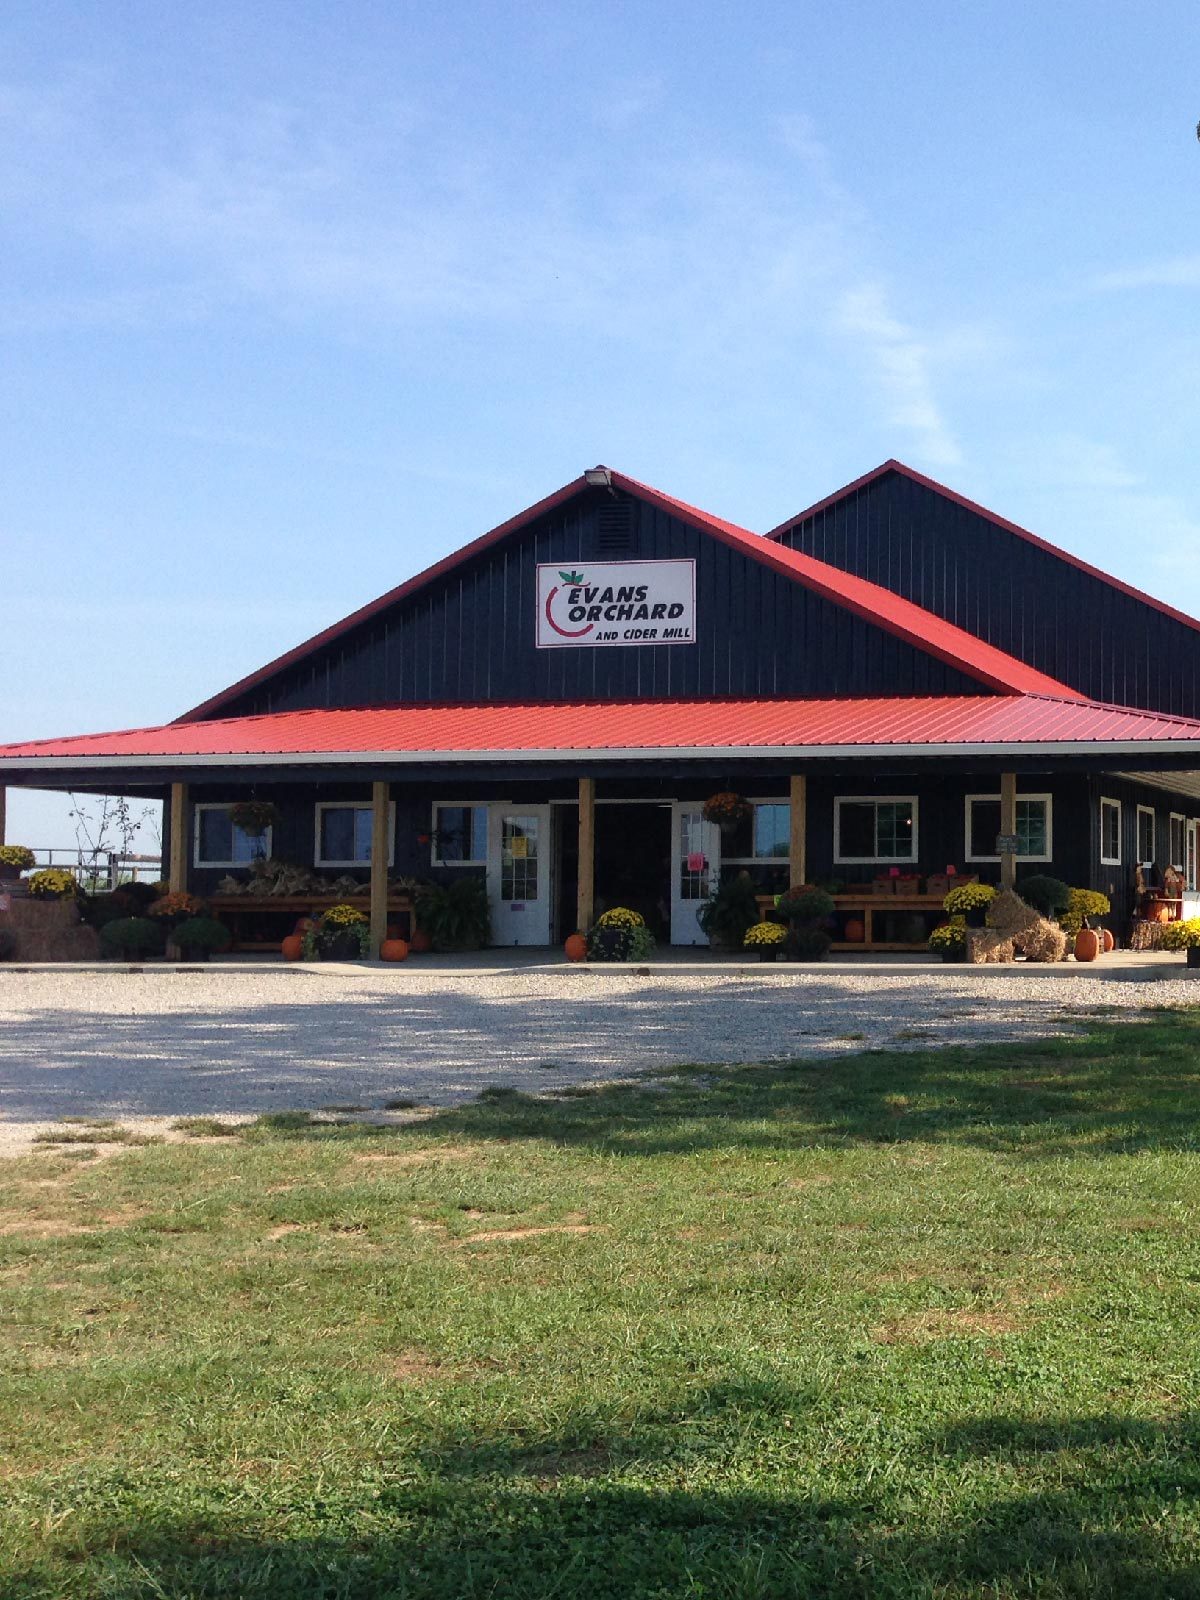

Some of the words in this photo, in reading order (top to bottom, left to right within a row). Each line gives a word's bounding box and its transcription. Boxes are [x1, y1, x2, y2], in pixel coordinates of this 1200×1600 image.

[568, 586, 648, 604] EVANS
[568, 603, 684, 622] ORCHARD
[596, 631, 619, 641] AND
[623, 628, 658, 640] CIDER
[662, 627, 691, 639] MILL
